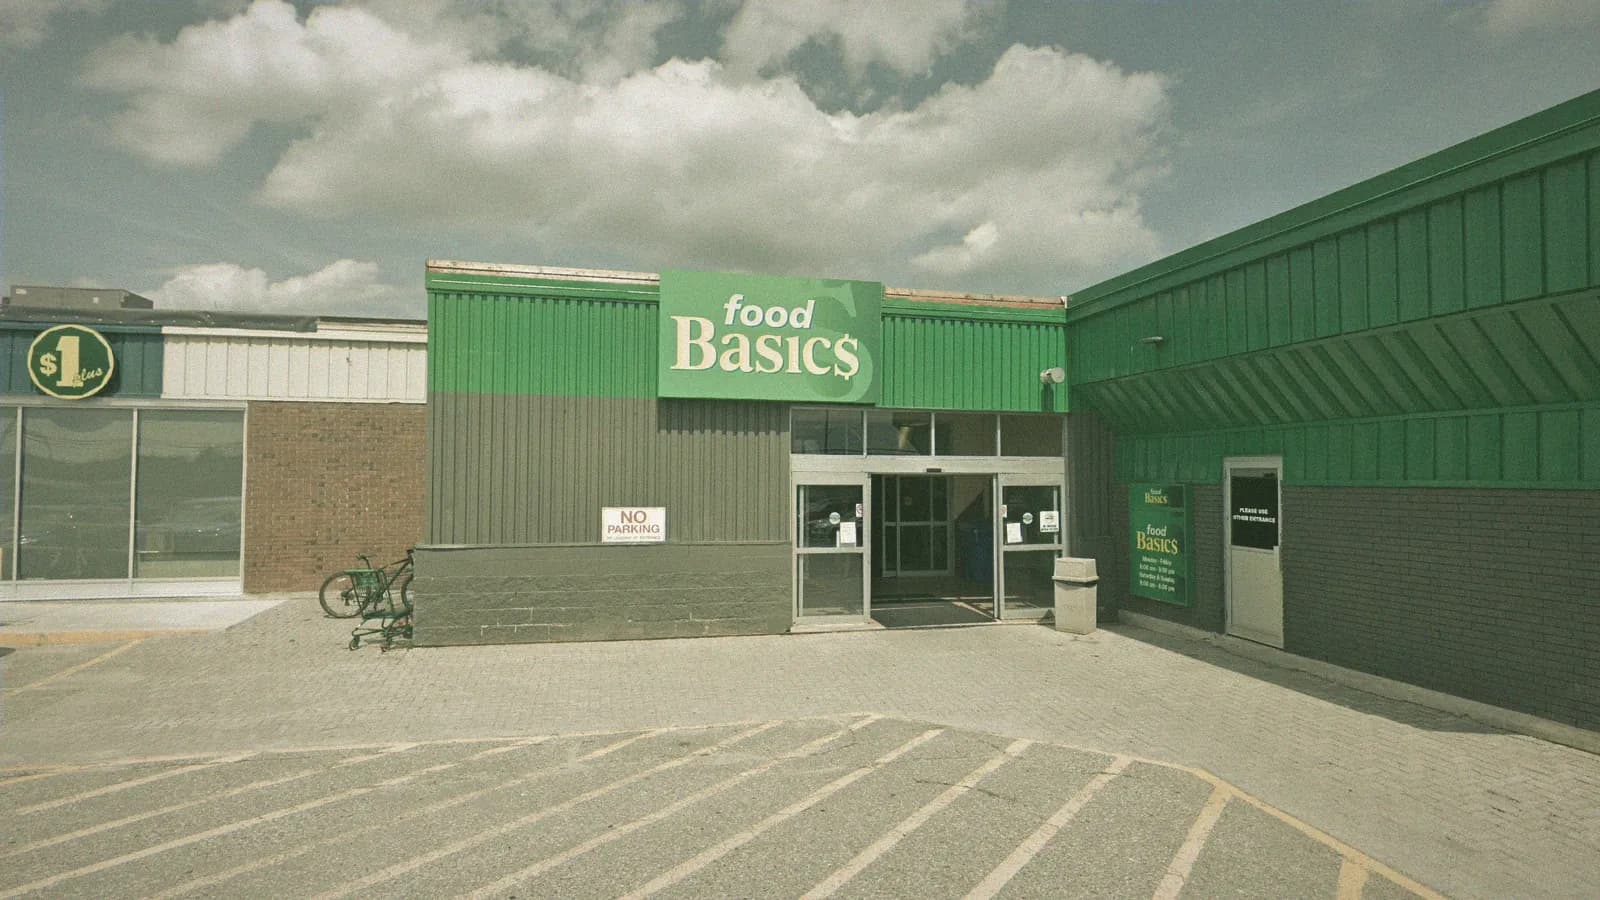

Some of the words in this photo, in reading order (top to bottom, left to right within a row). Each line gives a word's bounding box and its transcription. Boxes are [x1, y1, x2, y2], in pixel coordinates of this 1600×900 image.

[723, 294, 816, 329] food
[620, 510, 647, 524] NO
[607, 524, 660, 534] PARKING
[1146, 523, 1168, 537] food
